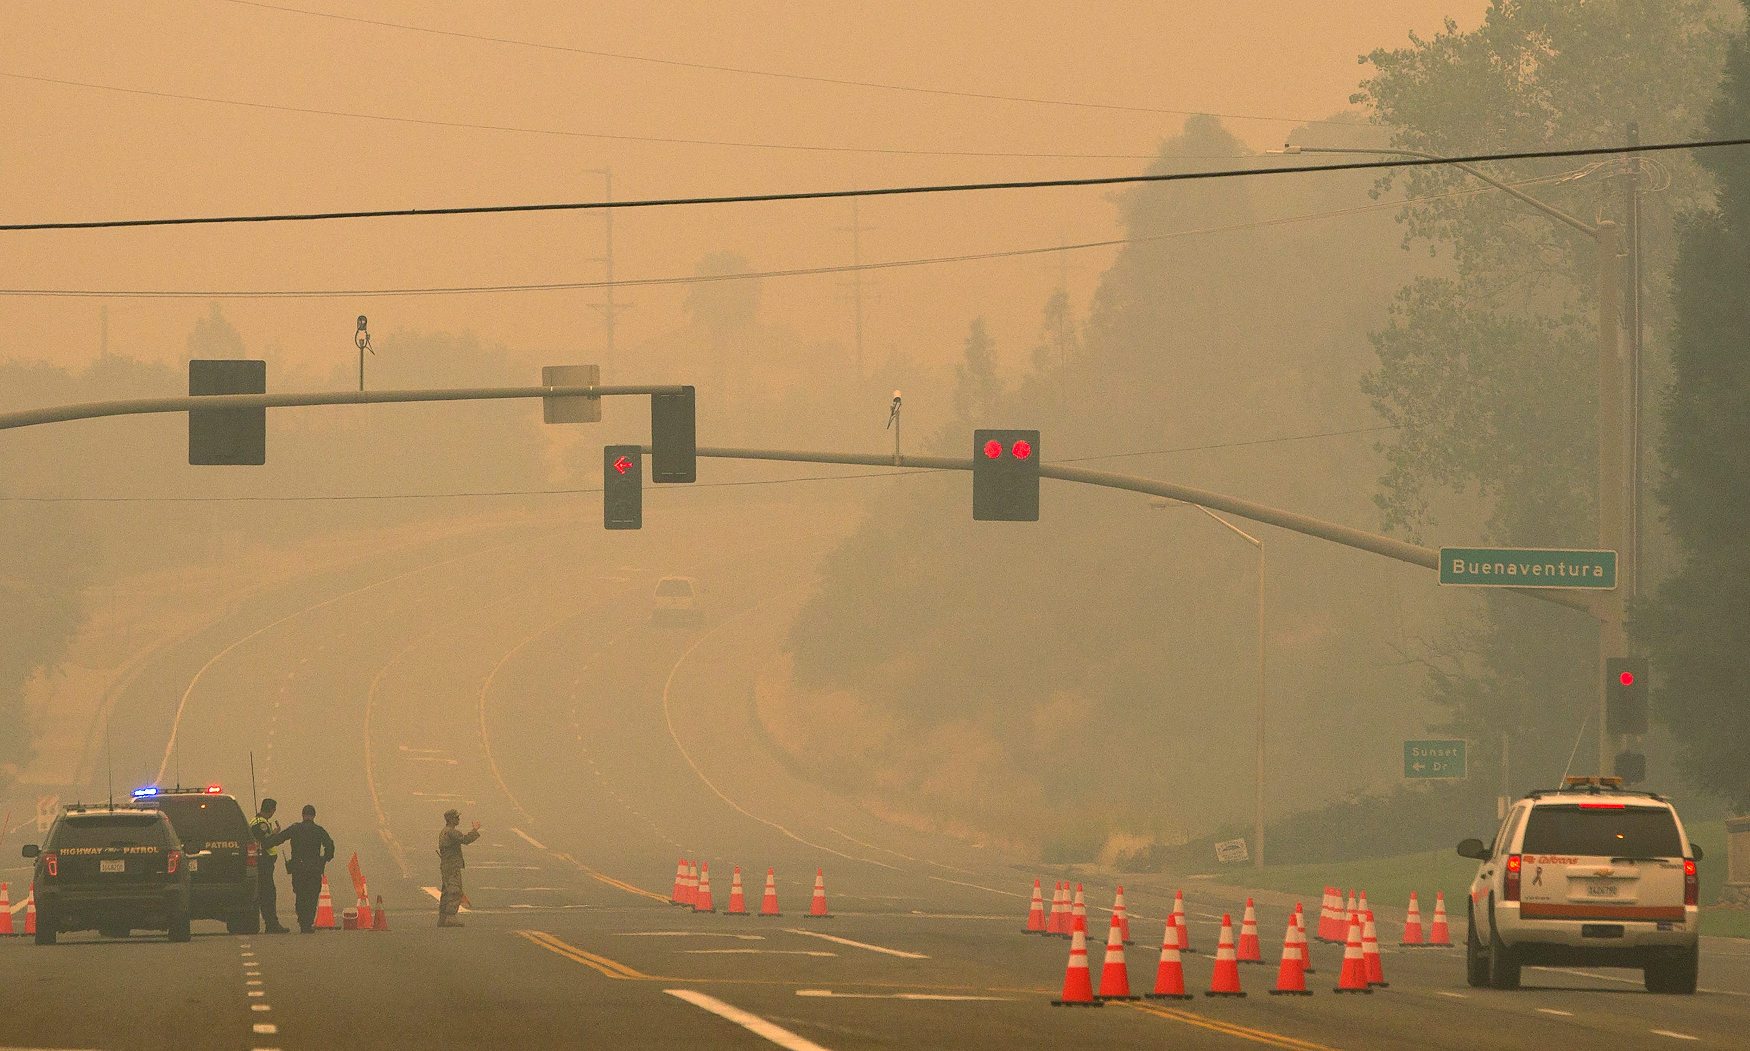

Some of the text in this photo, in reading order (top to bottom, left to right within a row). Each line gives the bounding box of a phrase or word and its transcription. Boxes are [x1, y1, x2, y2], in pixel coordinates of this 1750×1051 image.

[1452, 559, 1604, 577] Buenaventura
[1412, 747, 1457, 757] Sunset
[1433, 762, 1448, 771] Dr
[205, 841, 240, 849] PATROL
[60, 846, 160, 856] HIGHWAY PATROL
